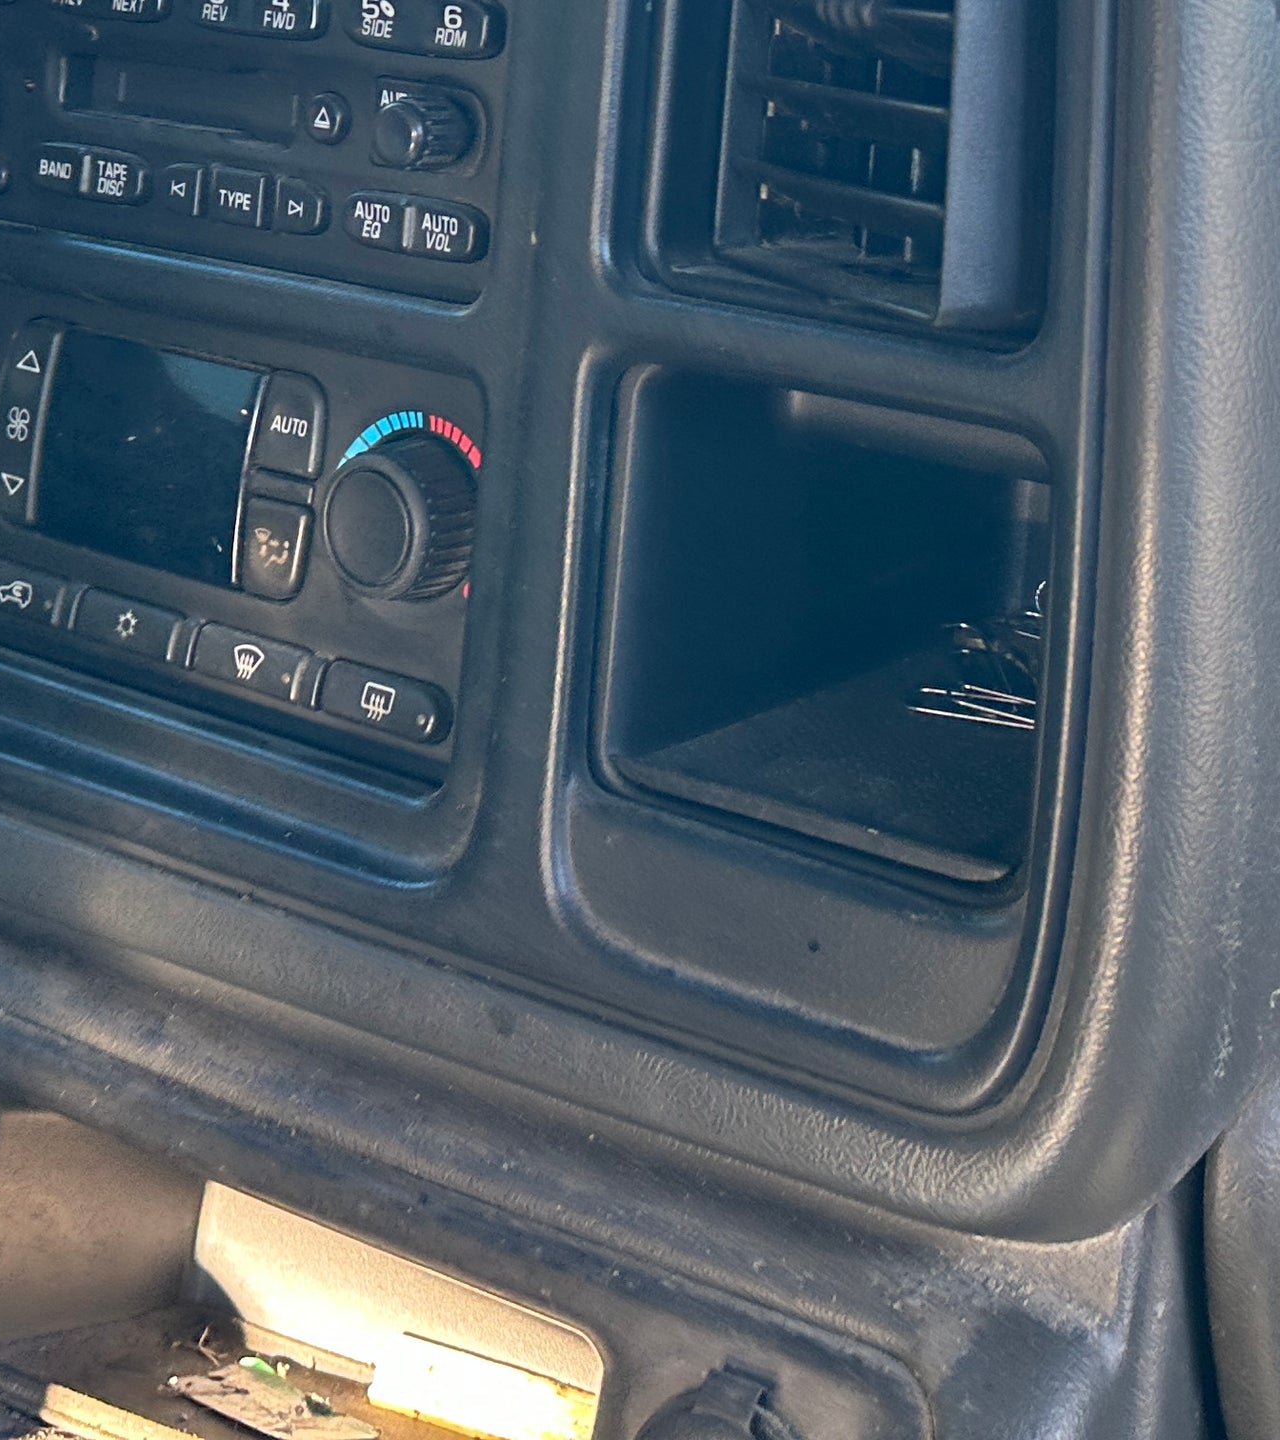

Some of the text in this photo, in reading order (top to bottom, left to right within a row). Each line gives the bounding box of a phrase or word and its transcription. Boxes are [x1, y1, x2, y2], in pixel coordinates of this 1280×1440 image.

[201, 2, 229, 22] REV
[262, 9, 297, 31] FWD
[443, 4, 463, 30] 6
[360, 17, 395, 39] SIDE
[434, 26, 468, 48] RDM
[39, 158, 72, 180] BAND
[97, 160, 128, 183] TAPE
[96, 176, 125, 197] DISC
[218, 188, 252, 211] TYPE
[353, 200, 391, 224] AUTO
[361, 220, 382, 239] EQ
[421, 212, 459, 236] AUTO
[425, 230, 453, 253] VOL
[270, 415, 308, 435] AUTO
